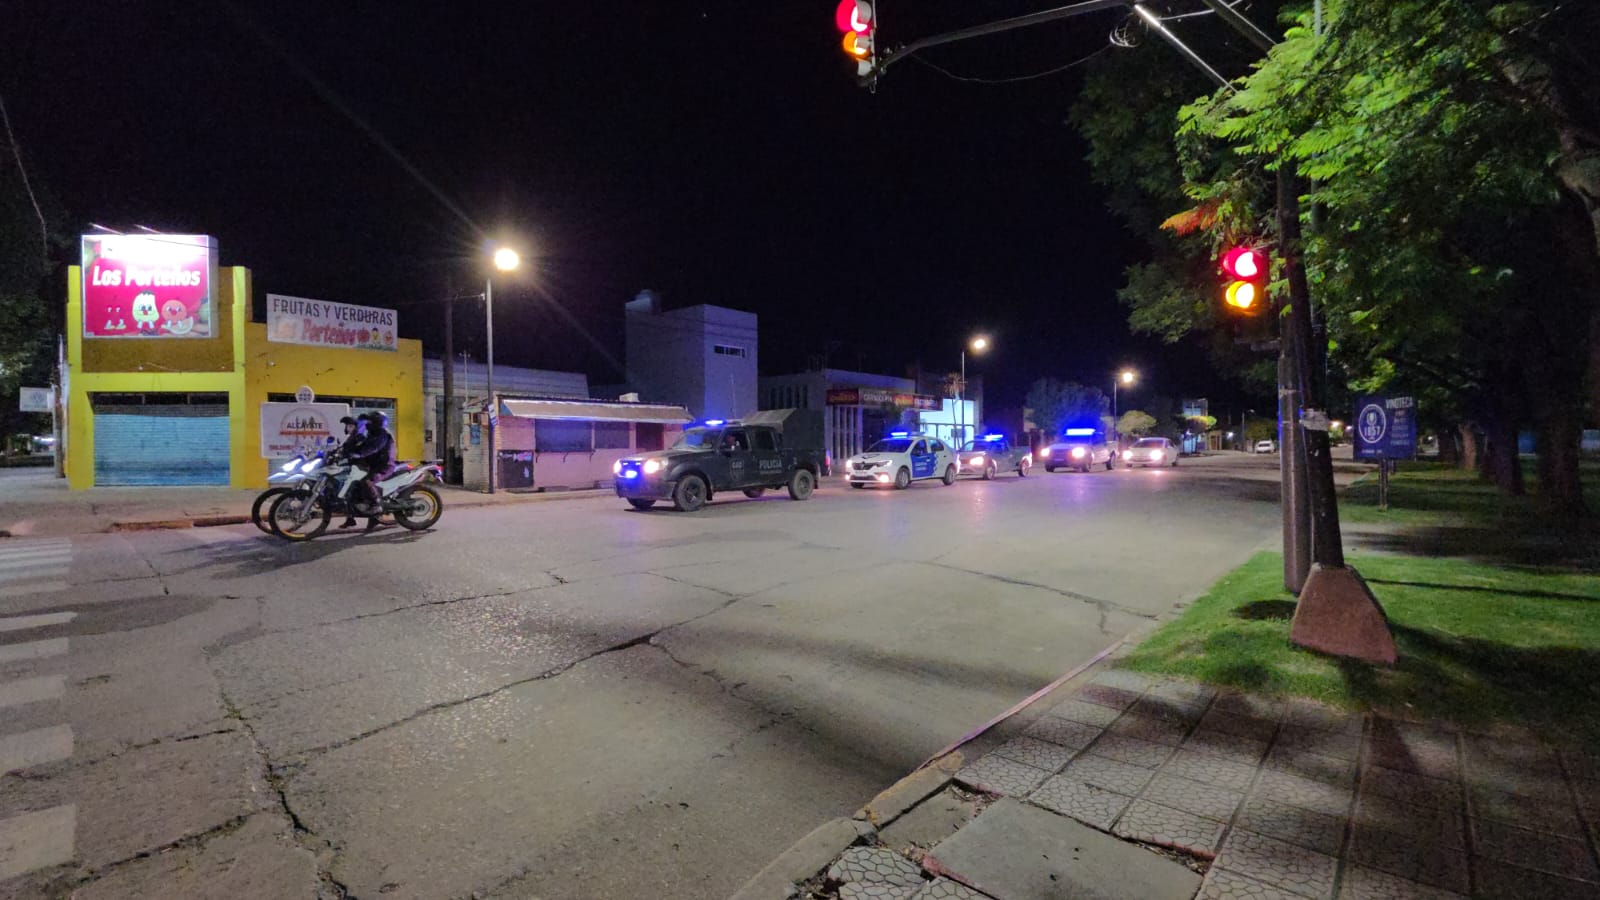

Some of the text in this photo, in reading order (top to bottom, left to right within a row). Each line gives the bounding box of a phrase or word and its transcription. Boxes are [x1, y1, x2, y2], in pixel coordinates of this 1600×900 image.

[92, 265, 122, 286] Los
[273, 298, 393, 326] FRUTAS Y VERDURAS
[302, 318, 357, 345] Porteños
[1385, 396, 1414, 409] VINOTECA
[286, 421, 324, 430] ALCAYATE
